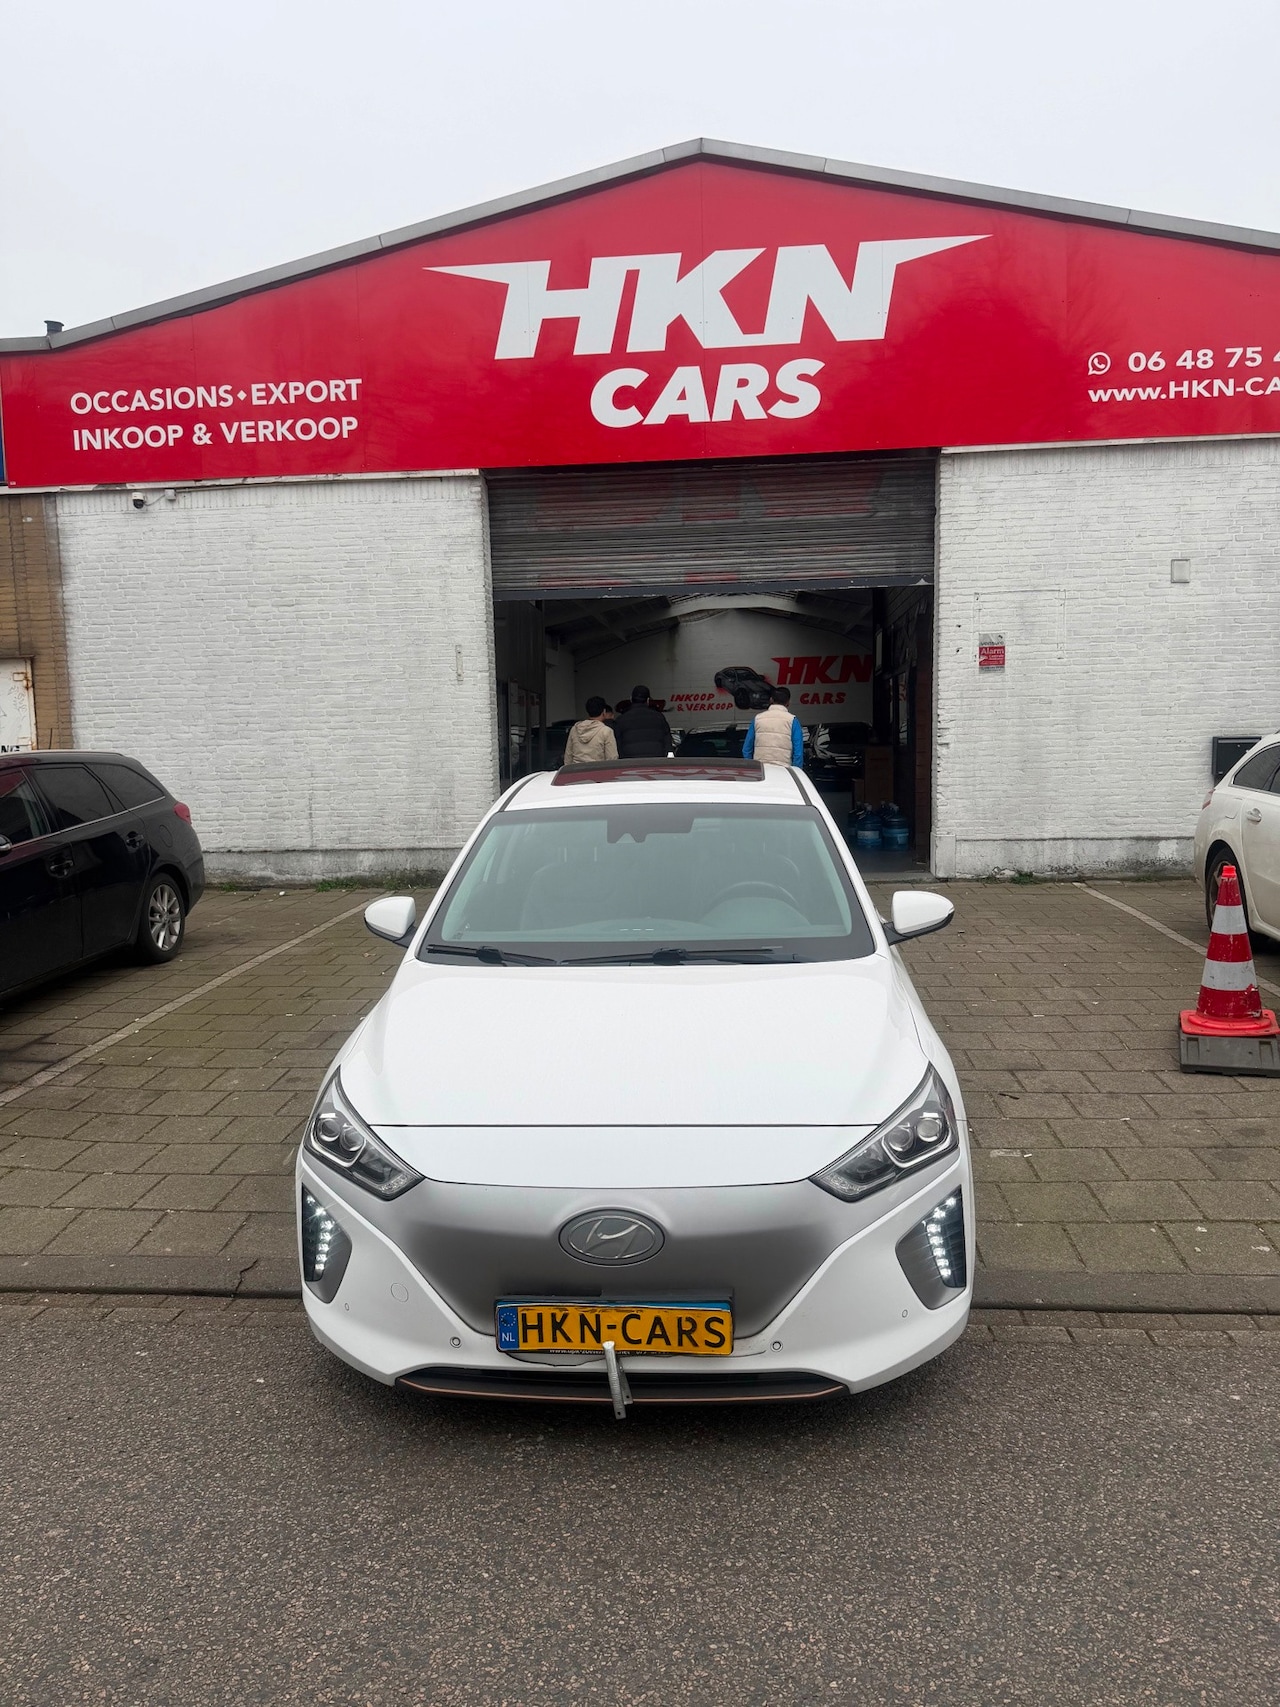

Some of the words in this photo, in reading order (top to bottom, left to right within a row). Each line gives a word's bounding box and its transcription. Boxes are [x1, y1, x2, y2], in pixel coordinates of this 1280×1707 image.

[422, 234, 994, 360] HKN
[1128, 351, 1167, 373] 06
[1175, 349, 1215, 371] 48
[1225, 347, 1263, 367] 75
[590, 358, 826, 428] CARS
[73, 424, 184, 451] INKOOP
[192, 423, 213, 446] &
[219, 416, 359, 444] VERKOOP
[771, 654, 874, 686] HKN
[670, 693, 715, 703] INKOOP
[676, 703, 684, 712] &
[685, 702, 733, 712] VERKOOP
[799, 692, 847, 705] CARS
[501, 1332, 516, 1342] NL
[521, 1312, 726, 1349] HKN-CARS
